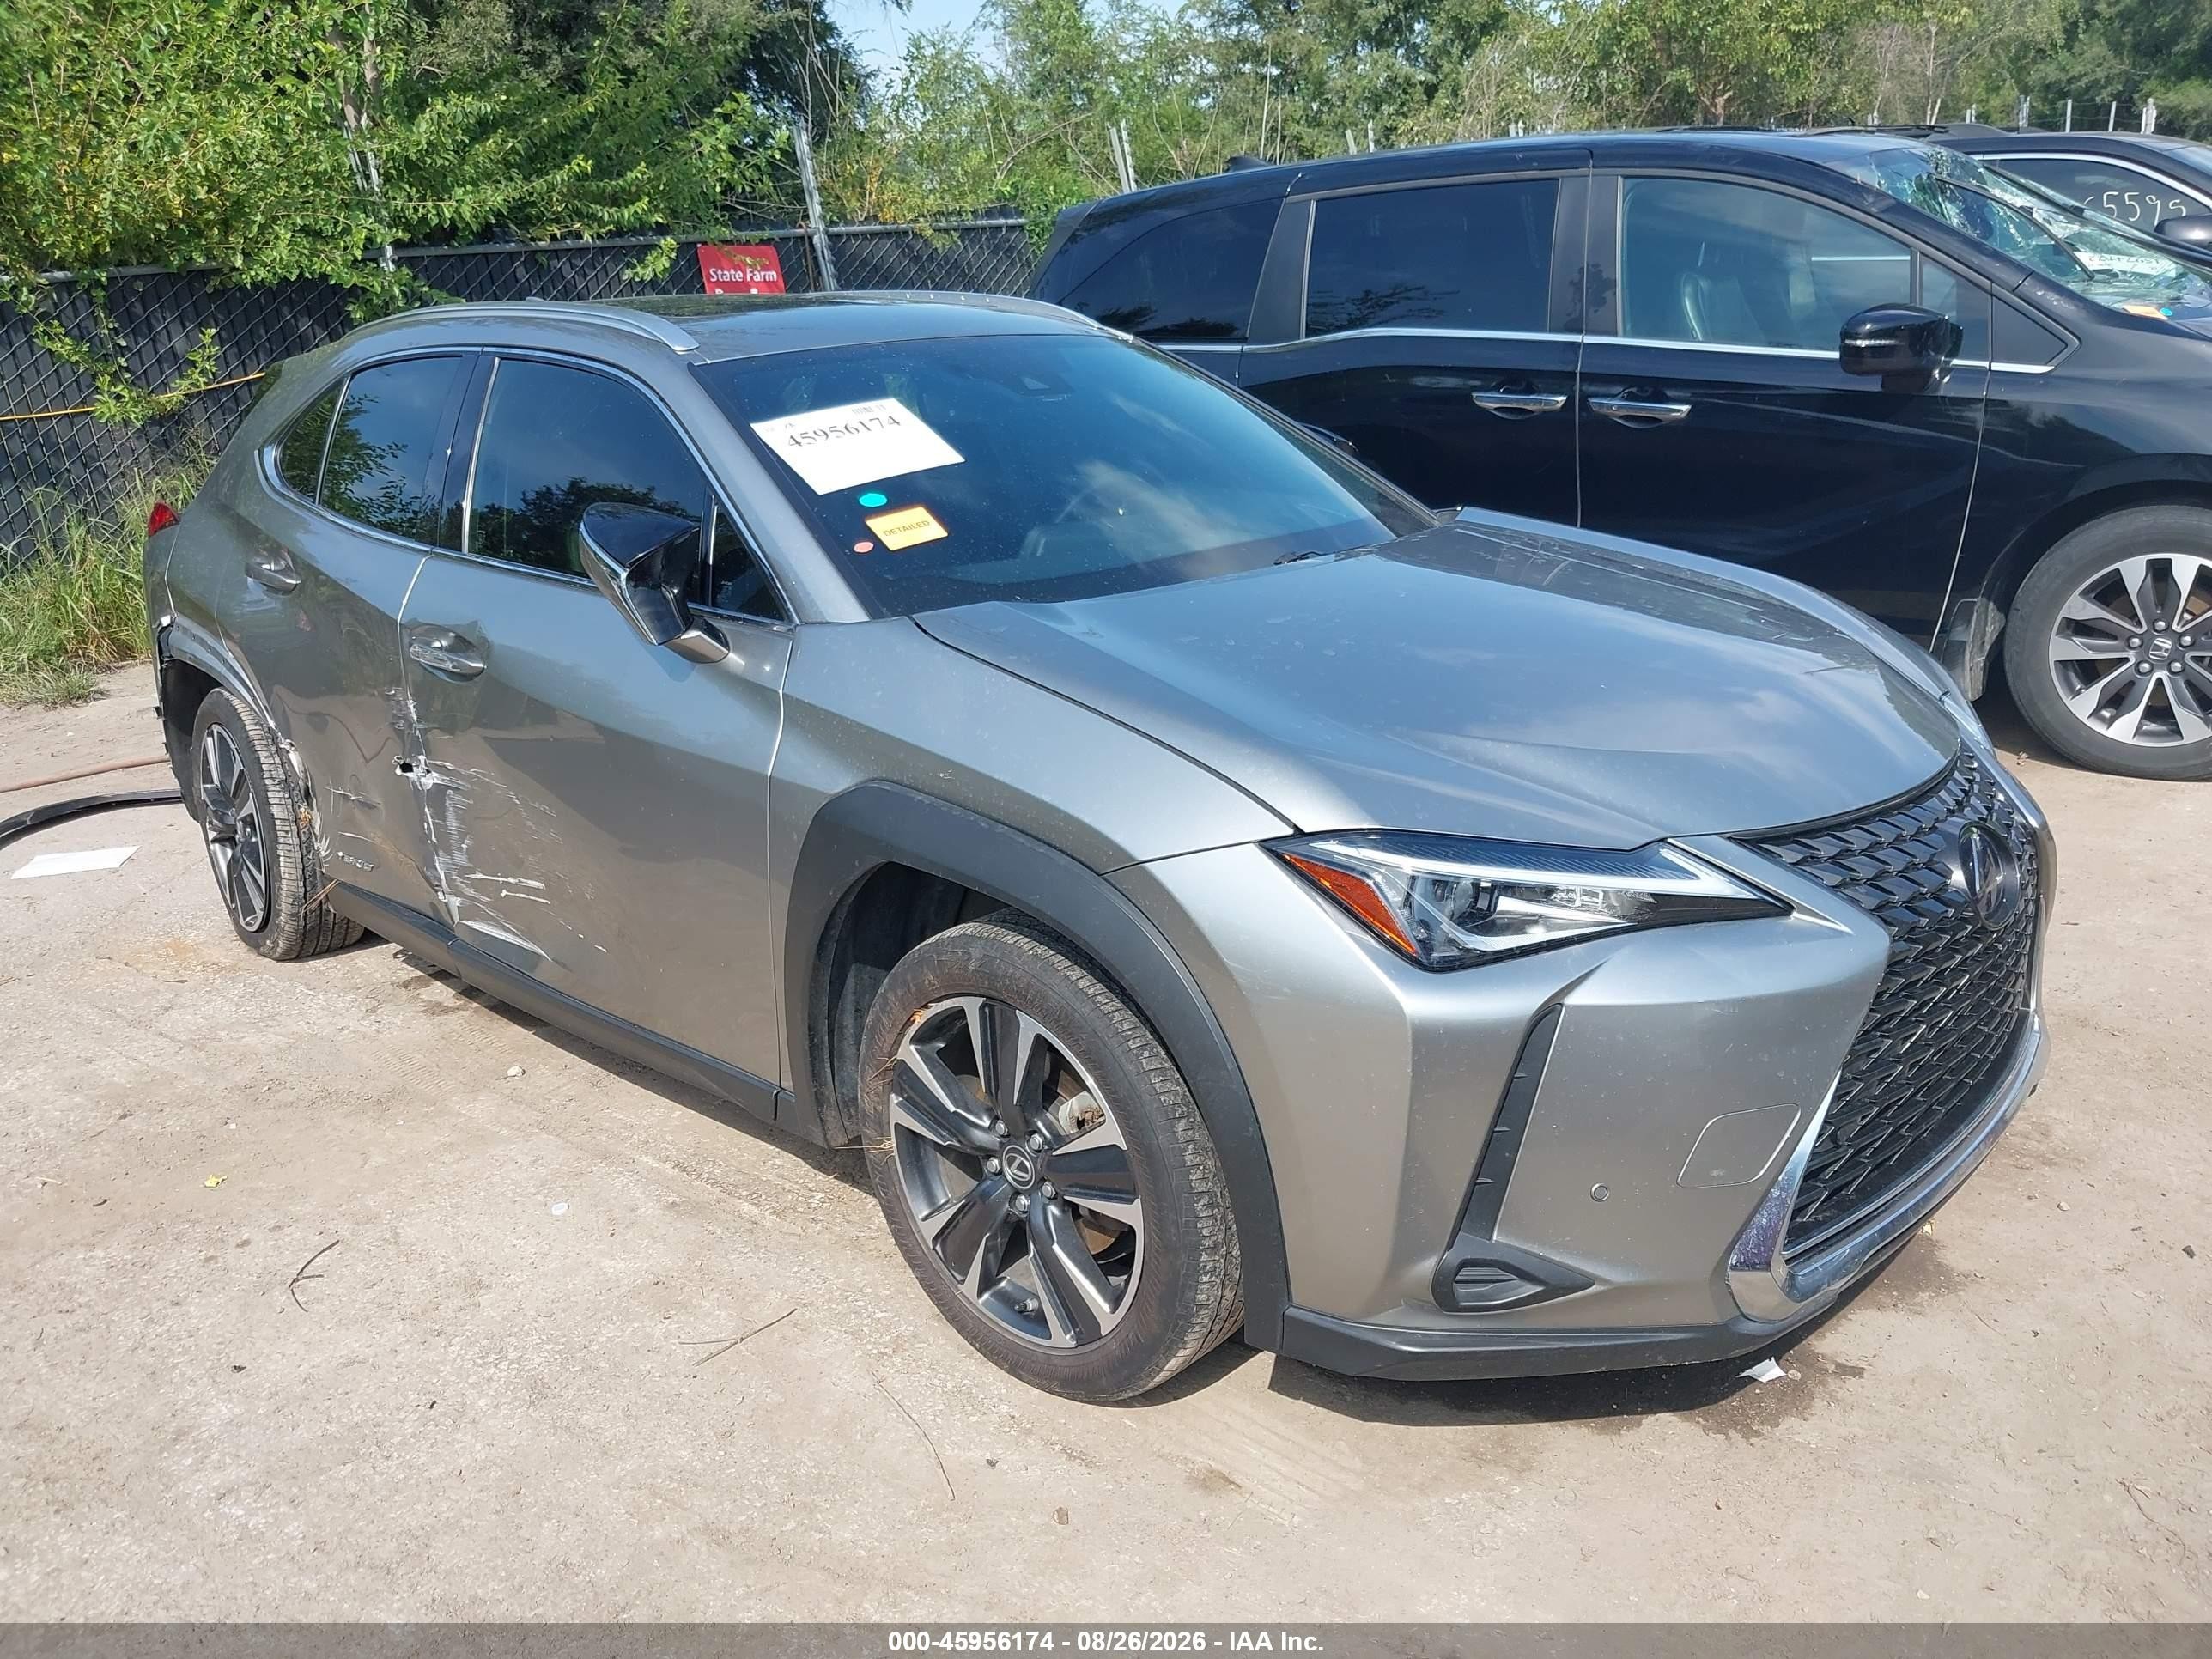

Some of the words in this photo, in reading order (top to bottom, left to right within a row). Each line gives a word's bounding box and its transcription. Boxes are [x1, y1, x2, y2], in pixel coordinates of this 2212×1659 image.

[709, 268, 744, 282] State
[746, 267, 777, 282] Farm
[787, 415, 901, 447] 45956174
[883, 520, 930, 537] DETAILED
